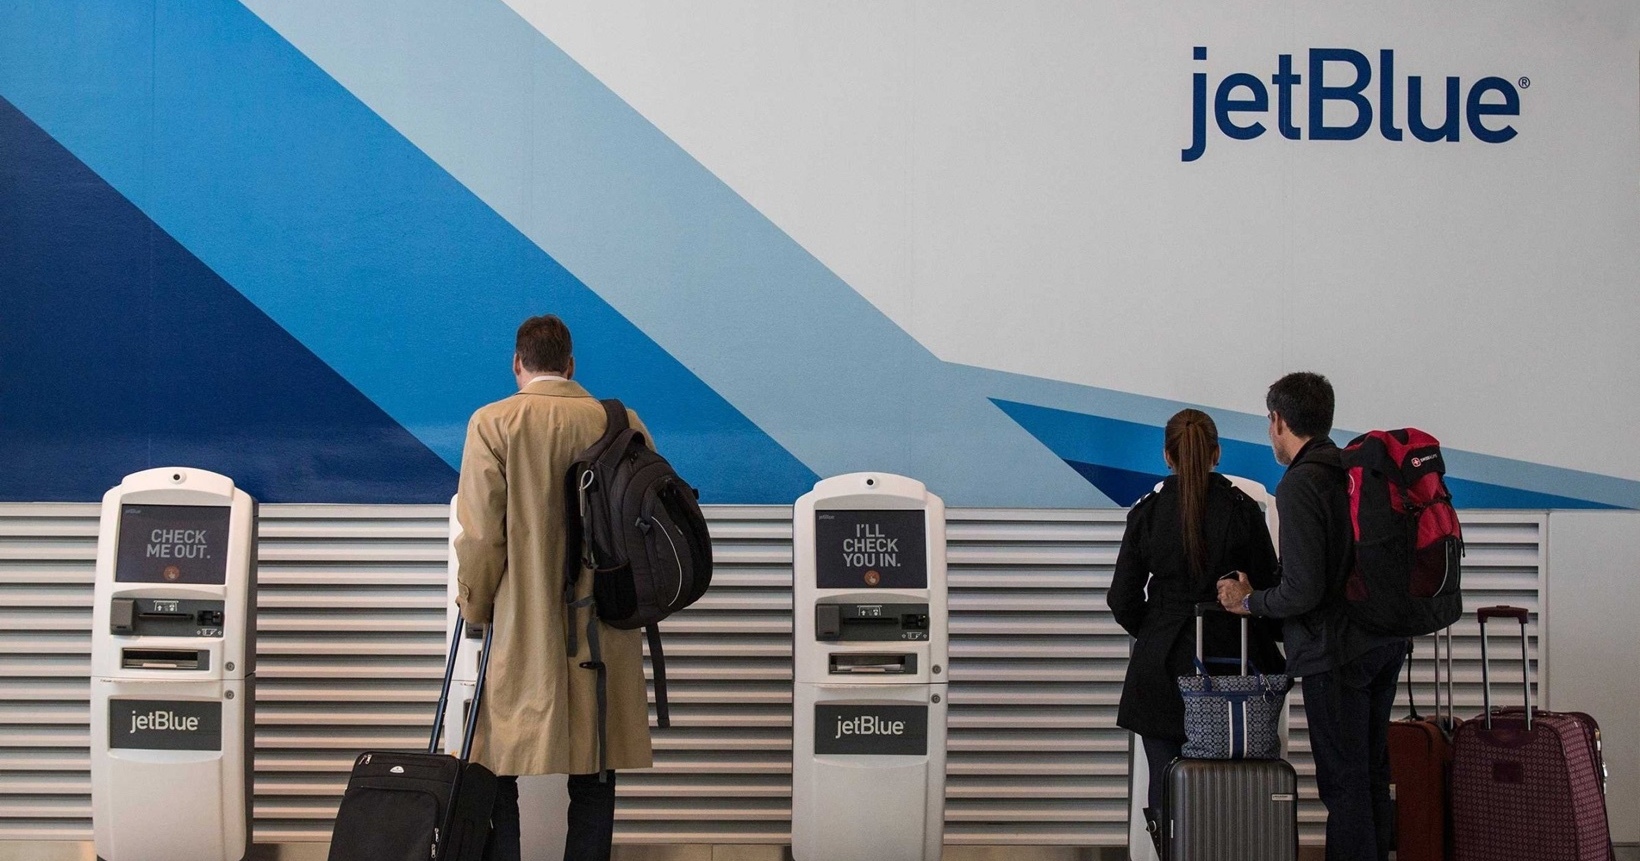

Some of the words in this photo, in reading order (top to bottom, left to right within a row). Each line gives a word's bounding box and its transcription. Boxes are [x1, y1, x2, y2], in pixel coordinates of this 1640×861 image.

[151, 528, 207, 544] CHECK
[856, 523, 886, 538] I'LL
[146, 543, 171, 558] ME
[174, 544, 211, 559] OUT.
[843, 538, 899, 552] CHECK
[842, 553, 876, 567] YOU
[879, 553, 901, 567] IN.
